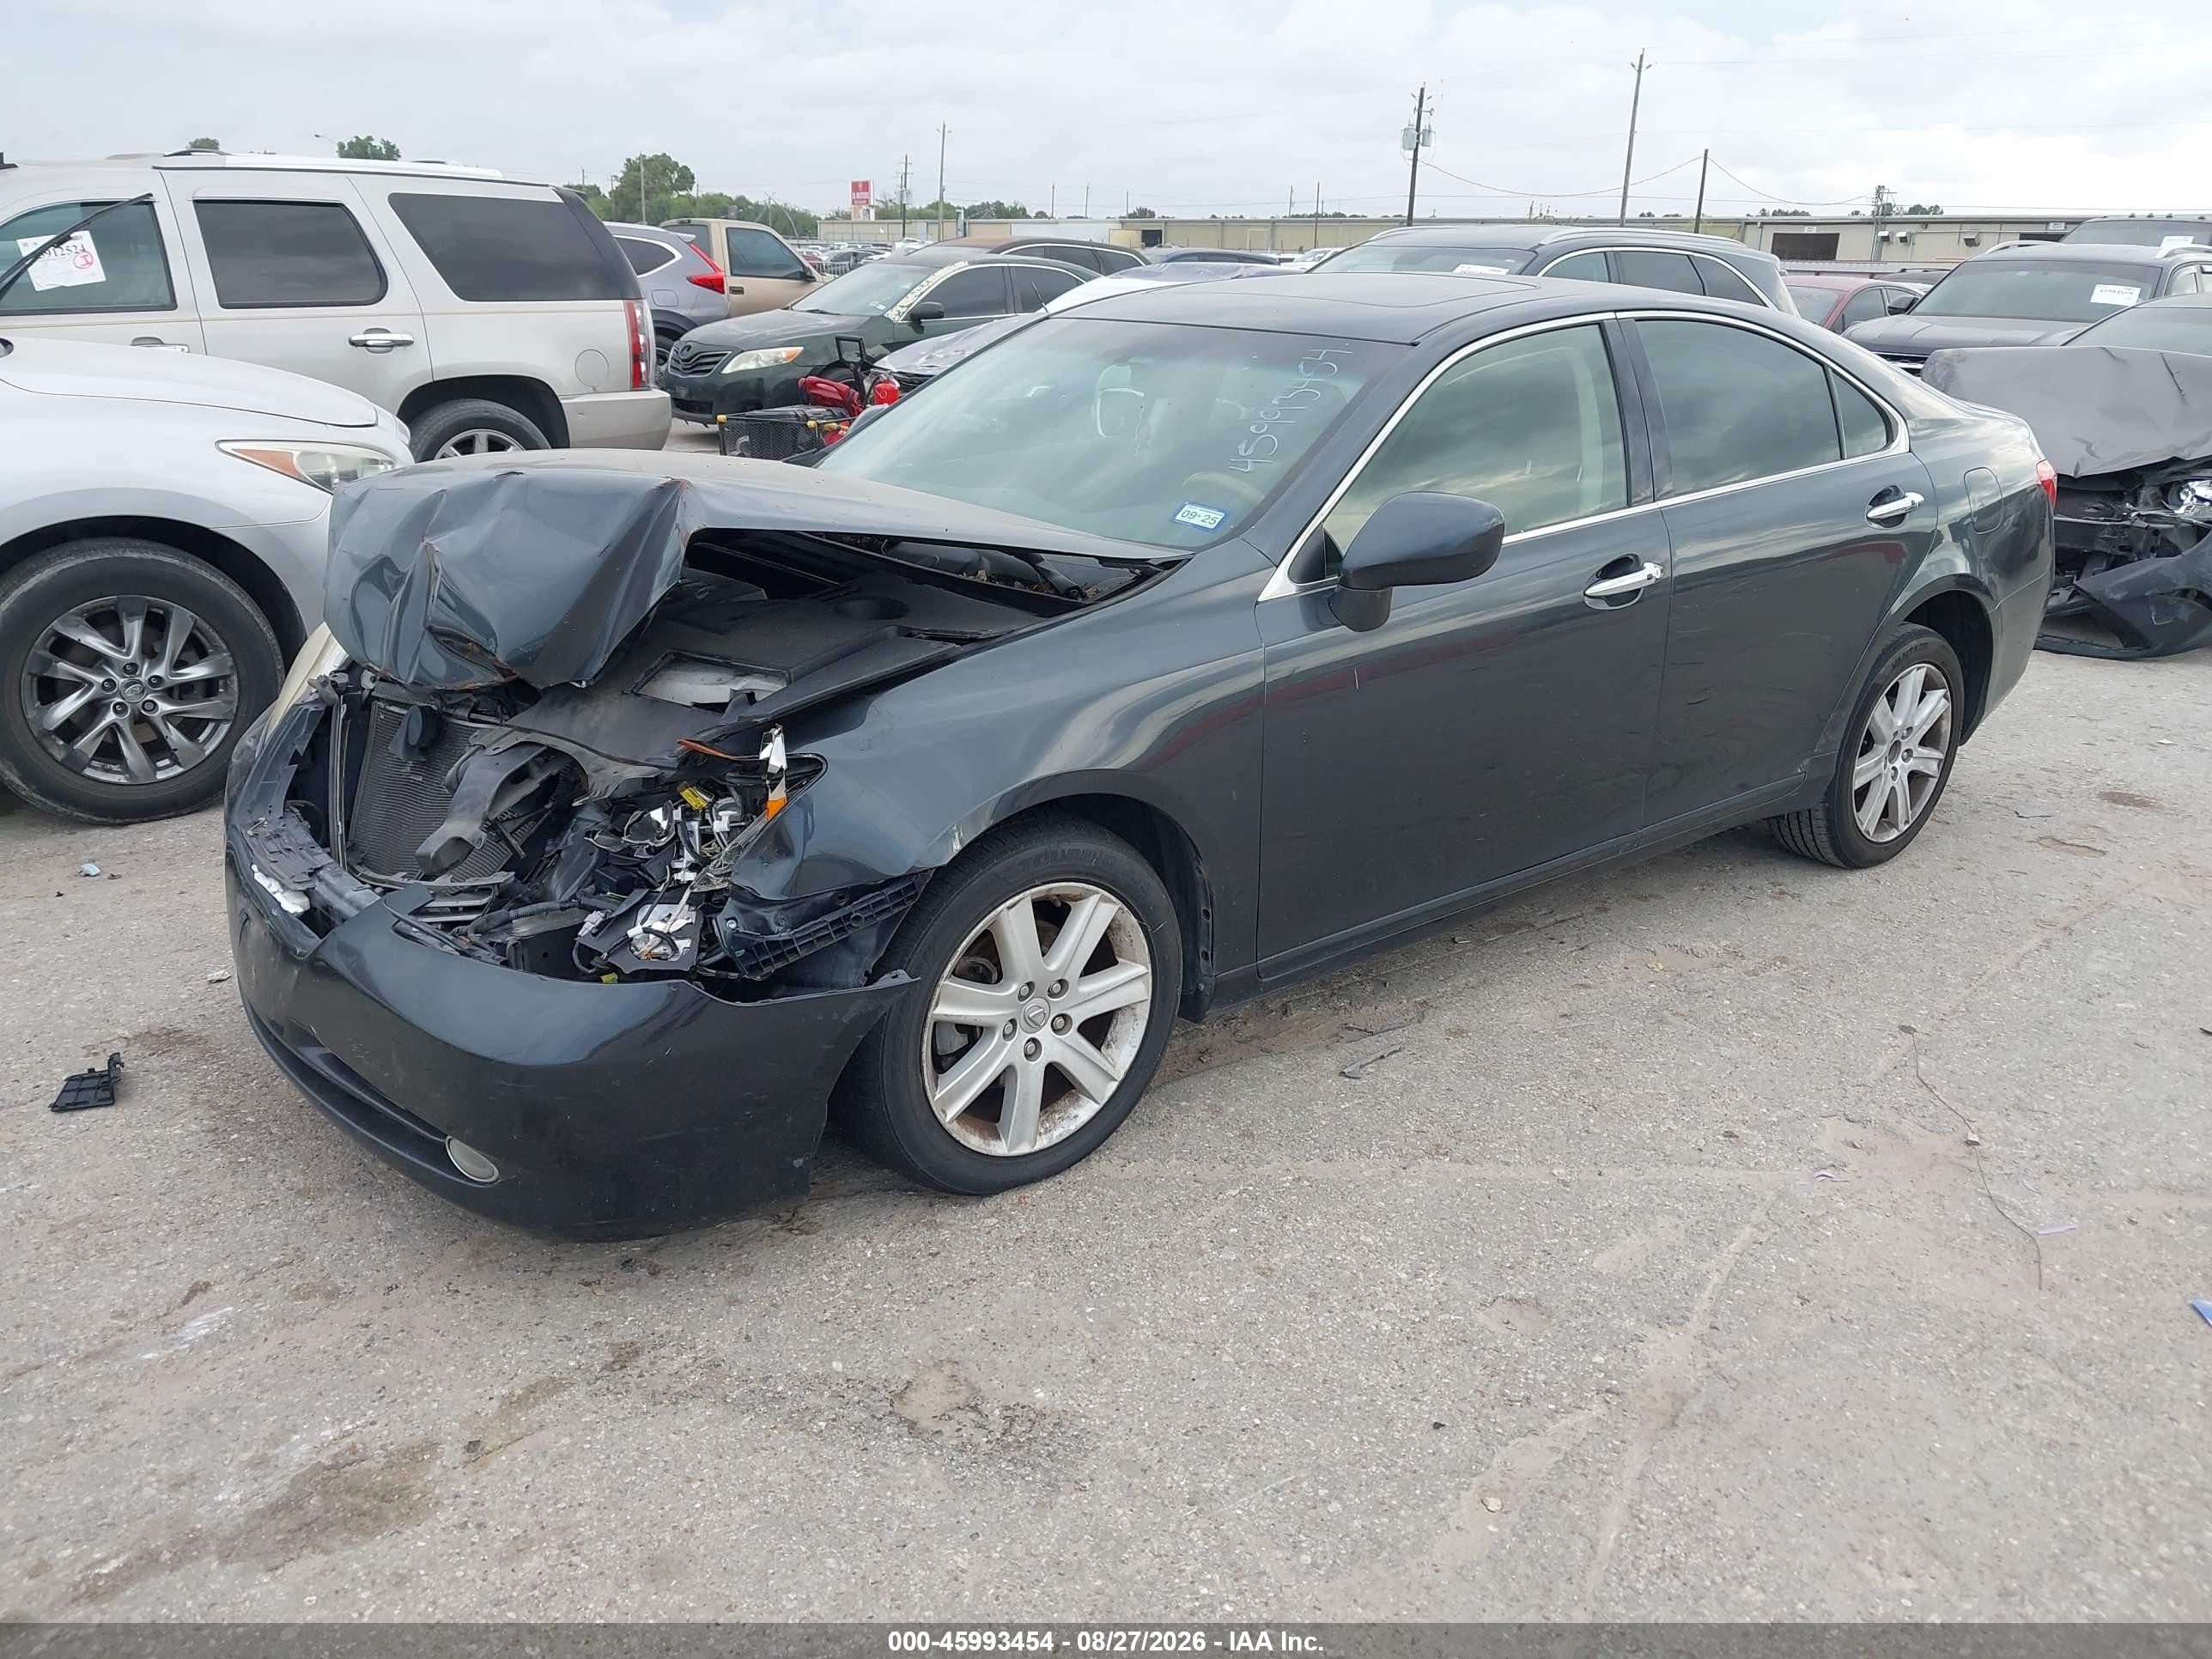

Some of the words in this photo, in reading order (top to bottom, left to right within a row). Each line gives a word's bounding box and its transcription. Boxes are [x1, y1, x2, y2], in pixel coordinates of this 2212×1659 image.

[1229, 349, 1354, 472] 45993454
[1181, 509, 1198, 520] 09
[1200, 514, 1219, 525] 25
